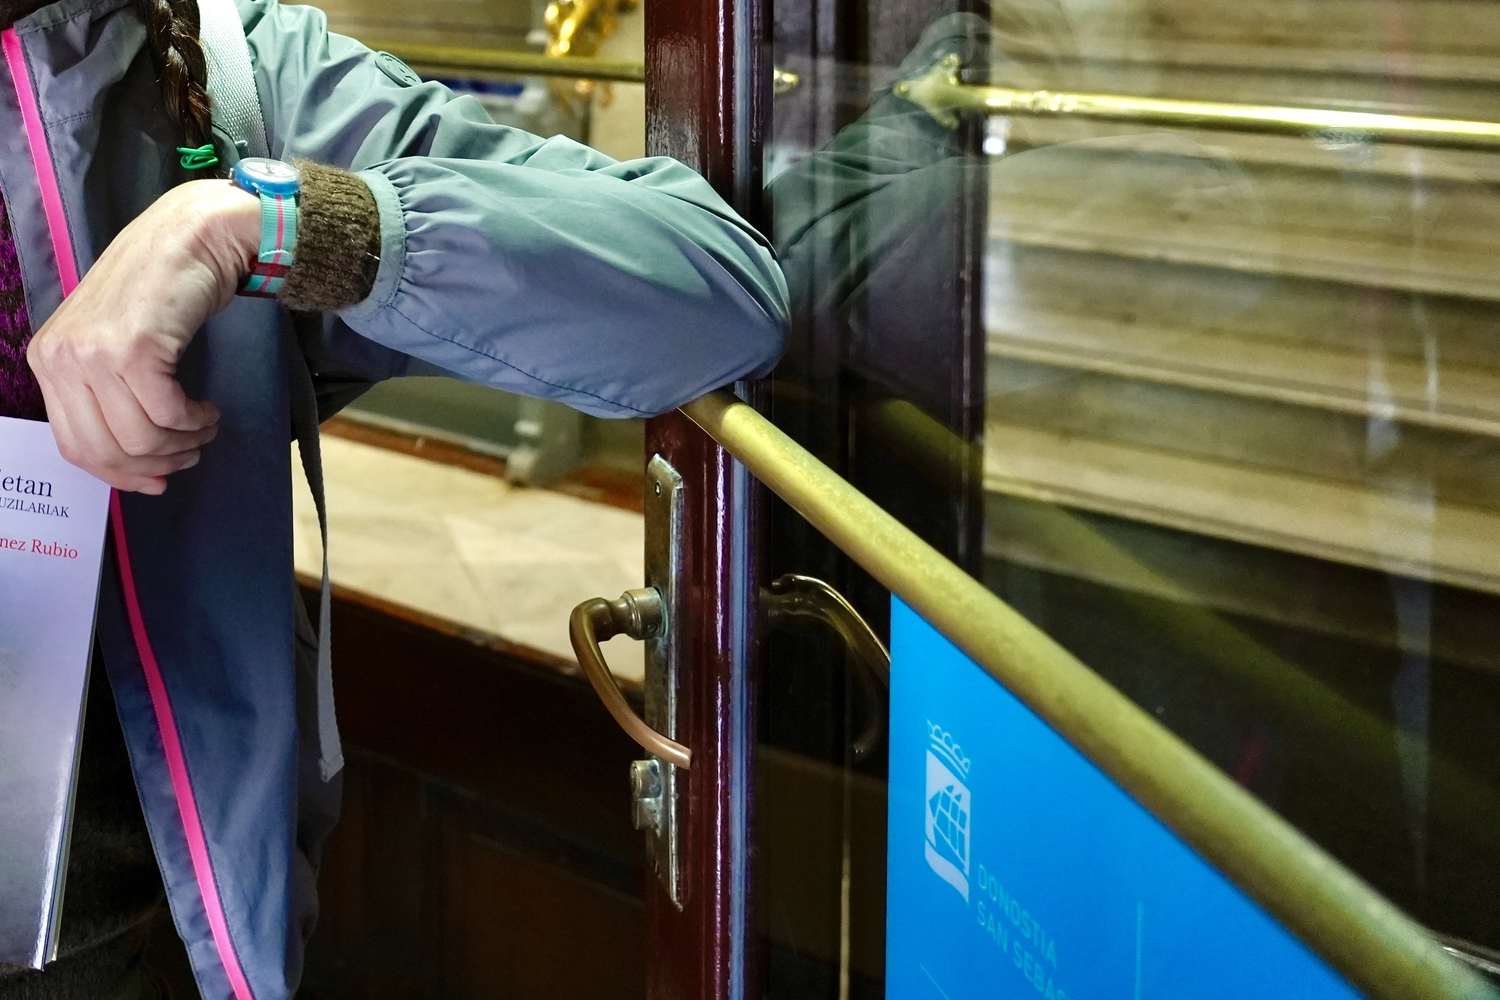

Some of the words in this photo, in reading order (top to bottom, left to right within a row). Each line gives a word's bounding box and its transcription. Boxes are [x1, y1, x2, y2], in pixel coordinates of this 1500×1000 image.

[30, 538, 79, 560] Rubio
[977, 900, 1009, 953] SAN
[978, 863, 1058, 970] DONOSTIA
